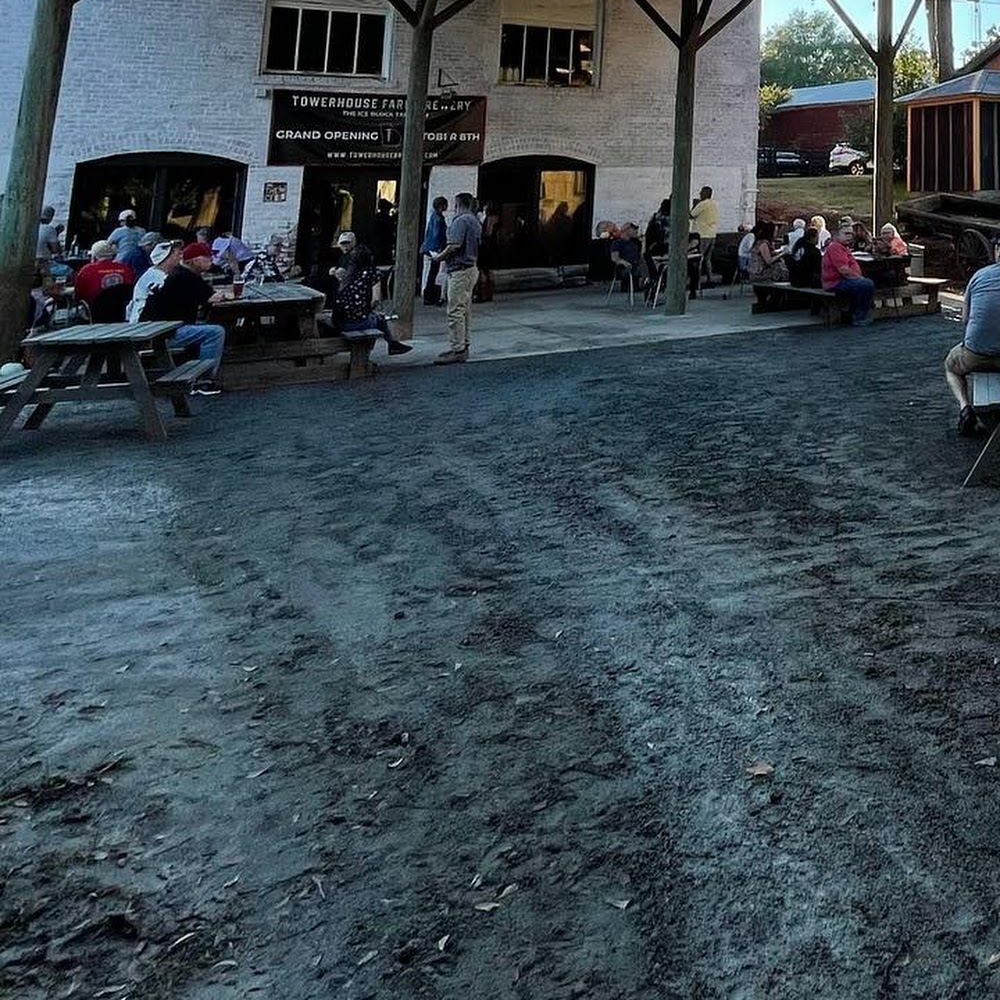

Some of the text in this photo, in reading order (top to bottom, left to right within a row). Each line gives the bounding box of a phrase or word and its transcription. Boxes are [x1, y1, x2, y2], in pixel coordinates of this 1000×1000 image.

[292, 95, 471, 111] TOWERHOUSE FAR REERY
[276, 130, 480, 141] GRAND OPENING TOBER 8TH
